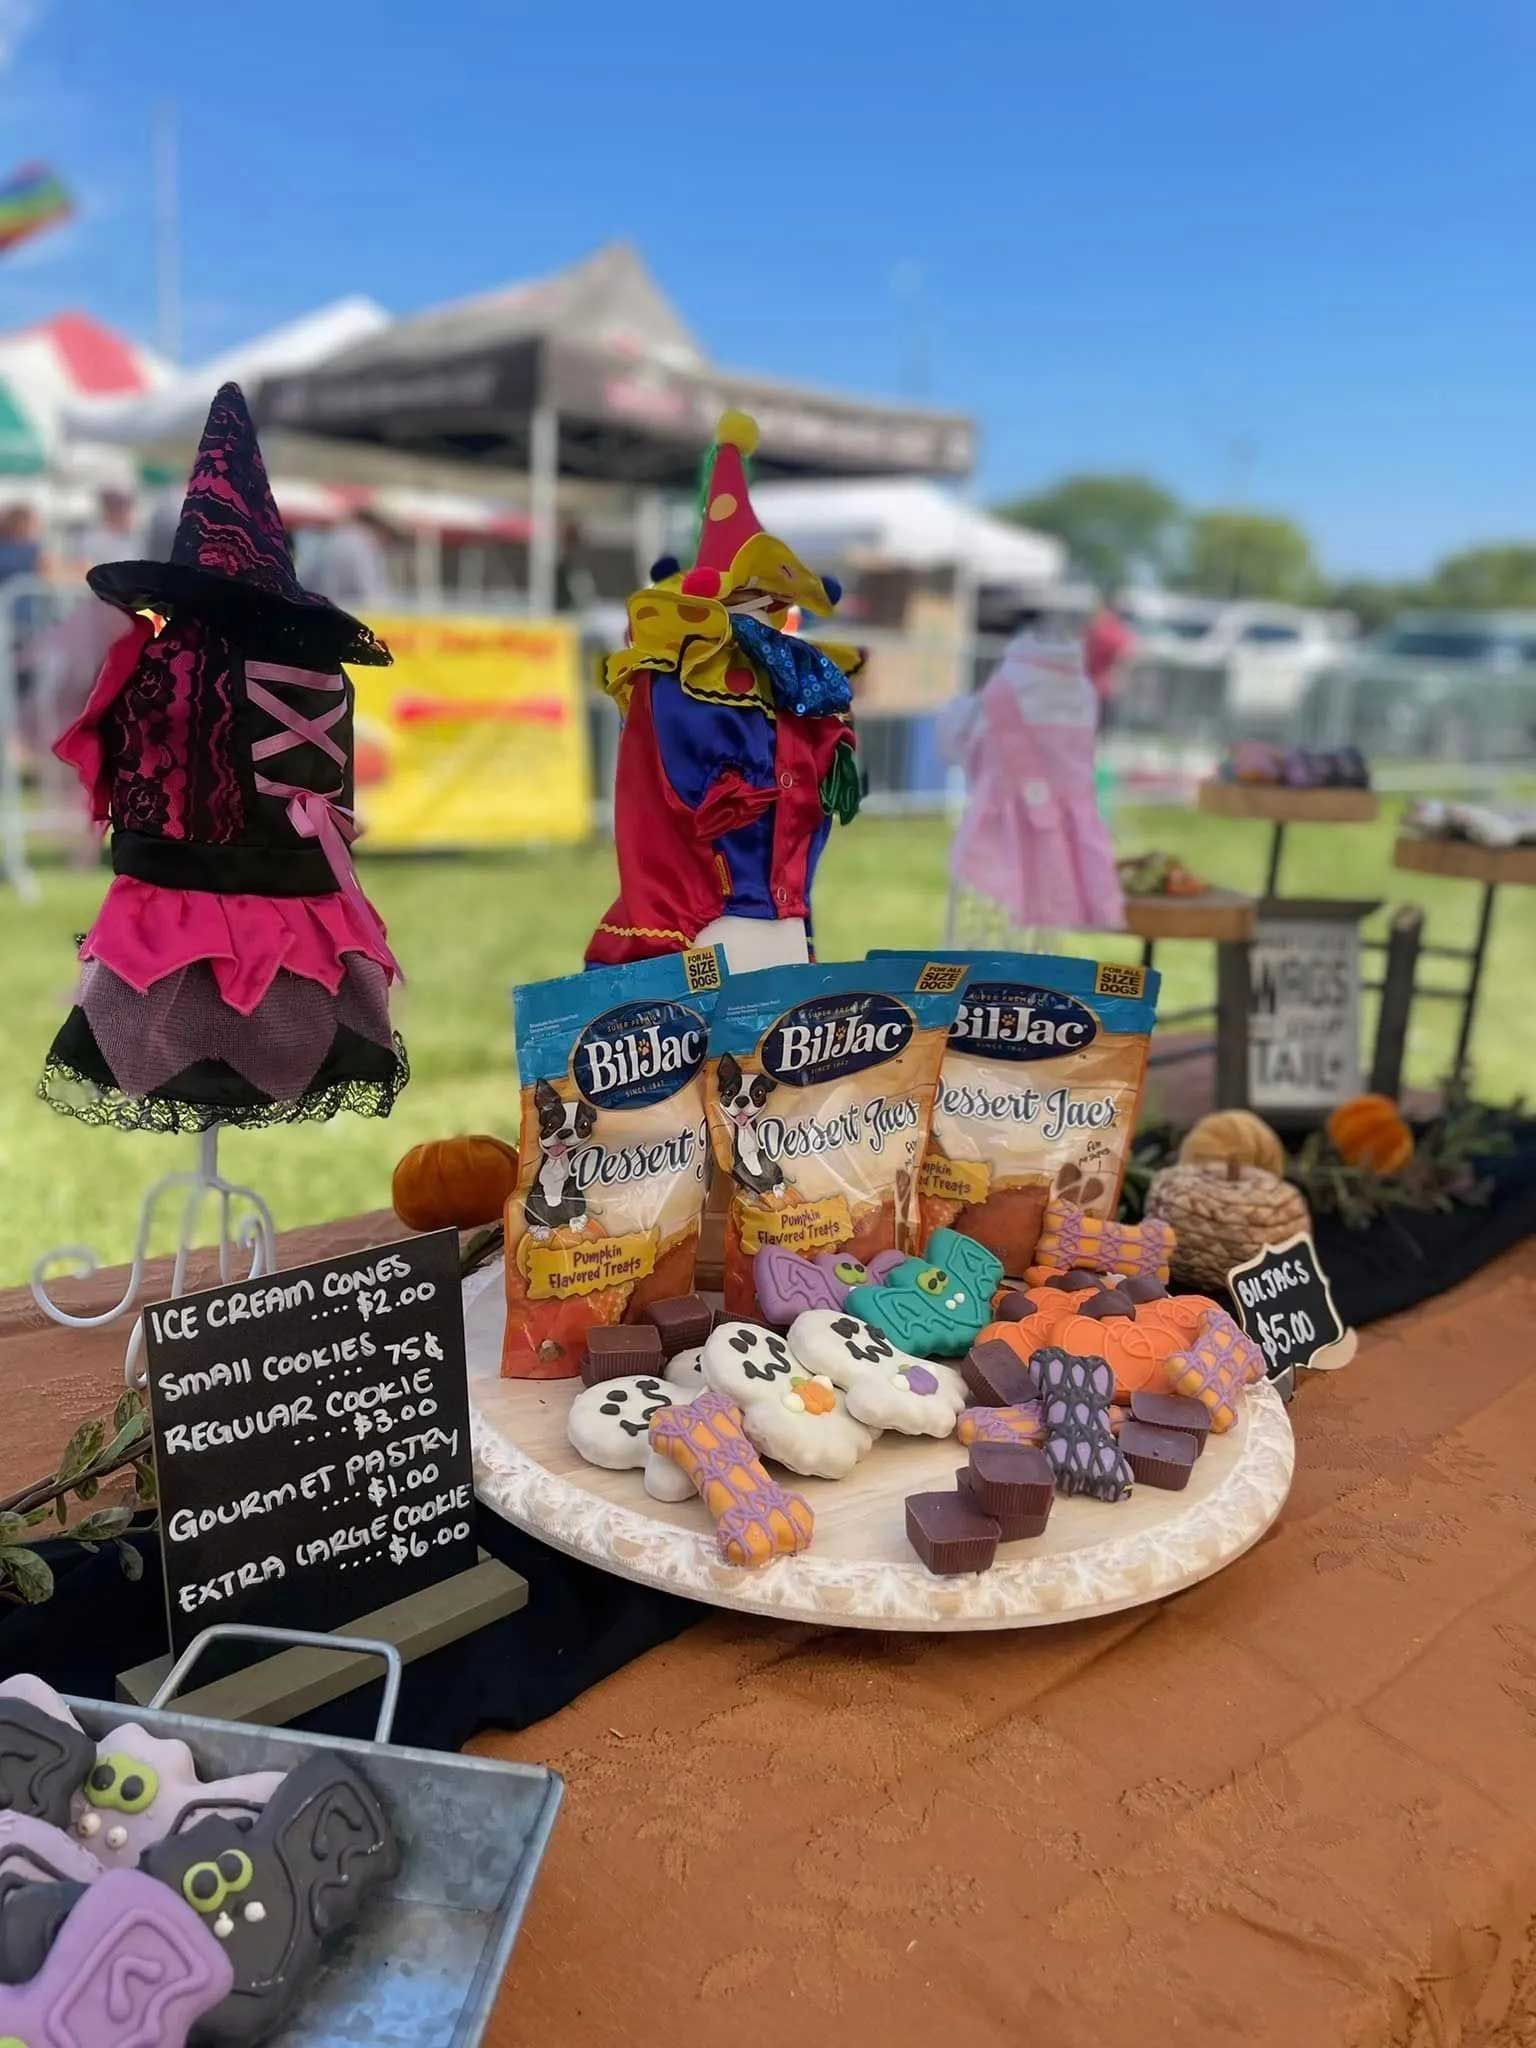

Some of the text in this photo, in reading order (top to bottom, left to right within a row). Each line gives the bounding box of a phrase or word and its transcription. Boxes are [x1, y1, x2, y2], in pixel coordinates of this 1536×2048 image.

[688, 951, 714, 964] FOR ALL
[689, 960, 717, 977] SIZE
[1103, 966, 1121, 974] FOR
[691, 973, 719, 989] DOGS
[919, 981, 956, 990] DOGS
[923, 972, 961, 981] SIZE
[1100, 983, 1138, 995] DOGS
[1101, 973, 1141, 985] SIZE
[758, 1104, 861, 1160] Dessert
[864, 1096, 918, 1152] Jacs
[1042, 1088, 1116, 1140] Jacs
[569, 1126, 695, 1190] Dessert
[932, 1175, 971, 1195] Treats
[757, 1219, 840, 1245] Flavored Treats
[781, 1209, 820, 1229] Pumpkin
[548, 1257, 641, 1289] Flavored Treats
[573, 1244, 622, 1268] Pumpkin
[151, 1254, 412, 1345] ICE CREAM CONES
[357, 1281, 436, 1322] $2.00
[262, 1331, 377, 1382] COOKIES
[1256, 1310, 1316, 1367] $5.00
[163, 1367, 433, 1455] REGULAR COOKIE
[353, 1398, 438, 1440] $3.00
[168, 1426, 459, 1542] GOURMET PASTRY
[368, 1463, 440, 1507] $1.00
[178, 1483, 471, 1613] EXTRA LARGE COOKIE
[388, 1521, 470, 1565] $6.00
